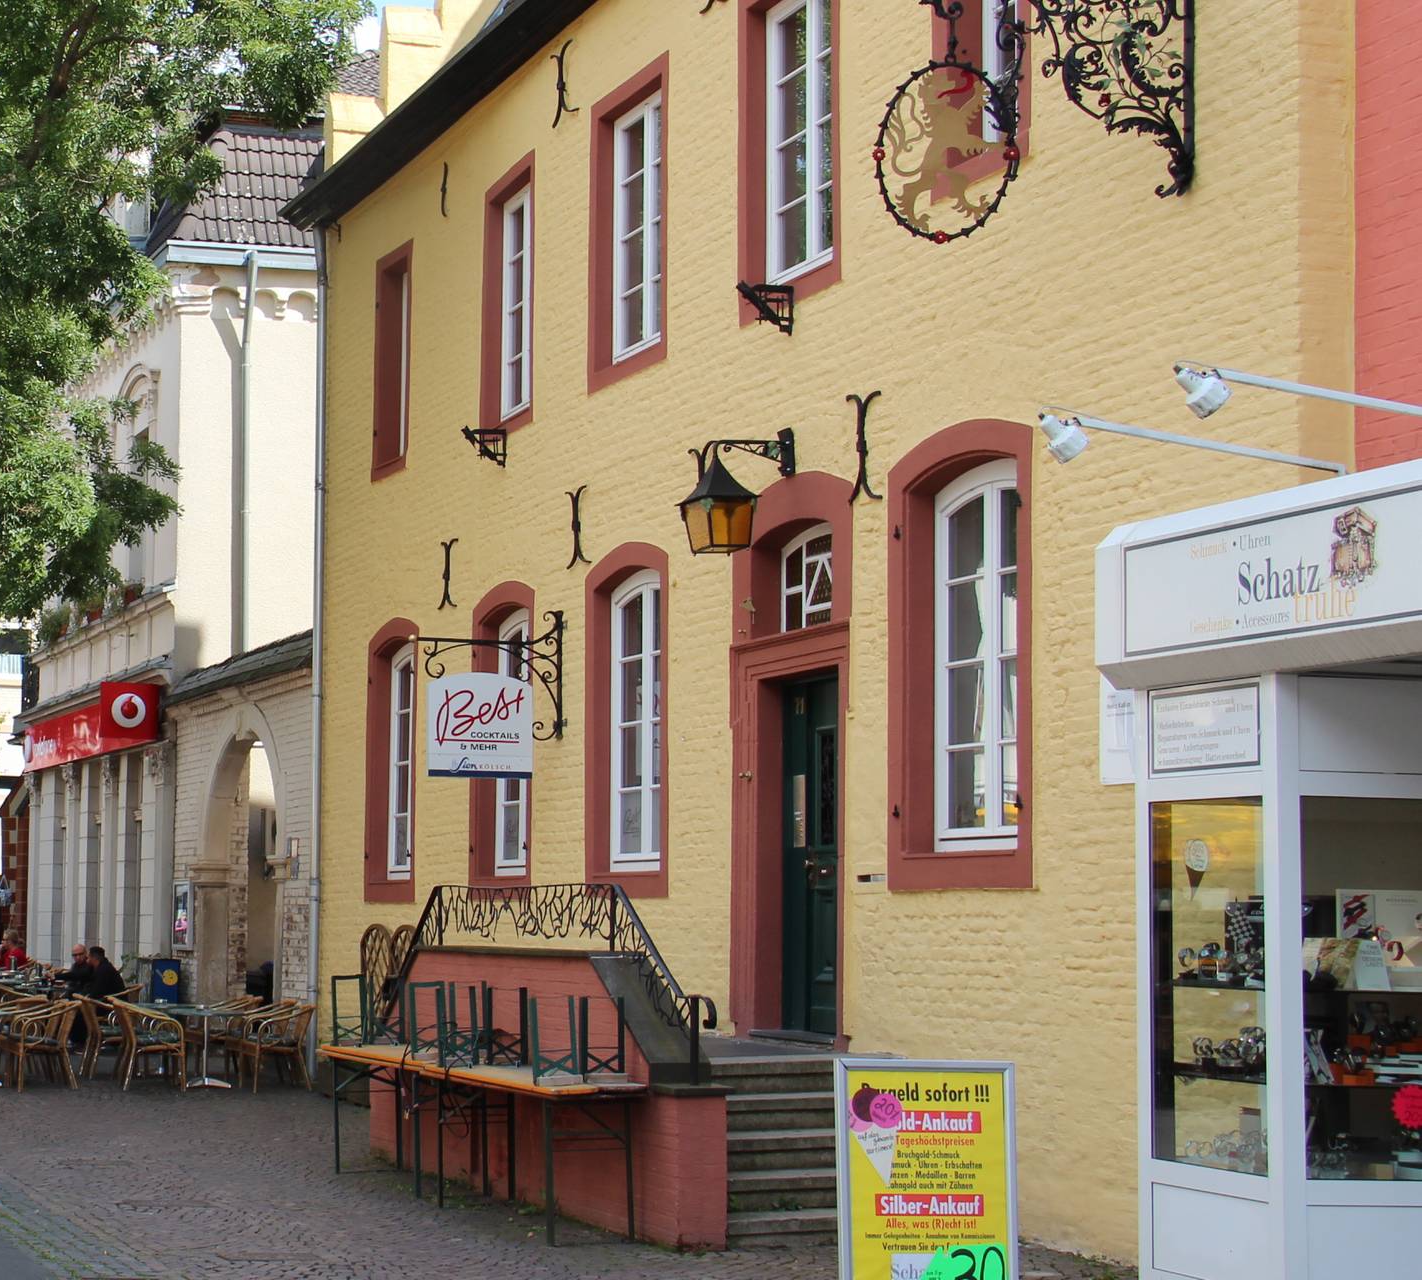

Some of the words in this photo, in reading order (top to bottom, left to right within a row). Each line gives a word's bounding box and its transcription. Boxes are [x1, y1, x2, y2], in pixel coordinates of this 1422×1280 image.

[1239, 534, 1271, 551] Uhren
[1293, 576, 1356, 624] truhe
[1241, 611, 1290, 630] Accessoires
[436, 687, 525, 747] Best
[470, 731, 520, 740] COCKTAILS
[470, 743, 498, 751] MEHR
[925, 1083, 970, 1102] sofort
[974, 1084, 989, 1102] !!!
[895, 1134, 975, 1148] Tageshöchstpreisen
[897, 1150, 960, 1160] Bruchgold-Schmuck
[919, 1160, 939, 1169] Uhren
[945, 1160, 983, 1169] Erbschaften
[915, 1171, 948, 1180] Medaillen
[954, 1172, 976, 1180] Barren
[936, 1181, 947, 1189] mit
[949, 1181, 974, 1190] Zähnen
[880, 1195, 980, 1215] Silber-Ankauf
[886, 1218, 909, 1230] Alles,
[913, 1221, 930, 1229] was
[932, 1218, 961, 1230] (R)echt
[963, 1219, 977, 1229] ist!
[882, 1242, 917, 1251] Vertrauen
[918, 1242, 929, 1251] Sie
